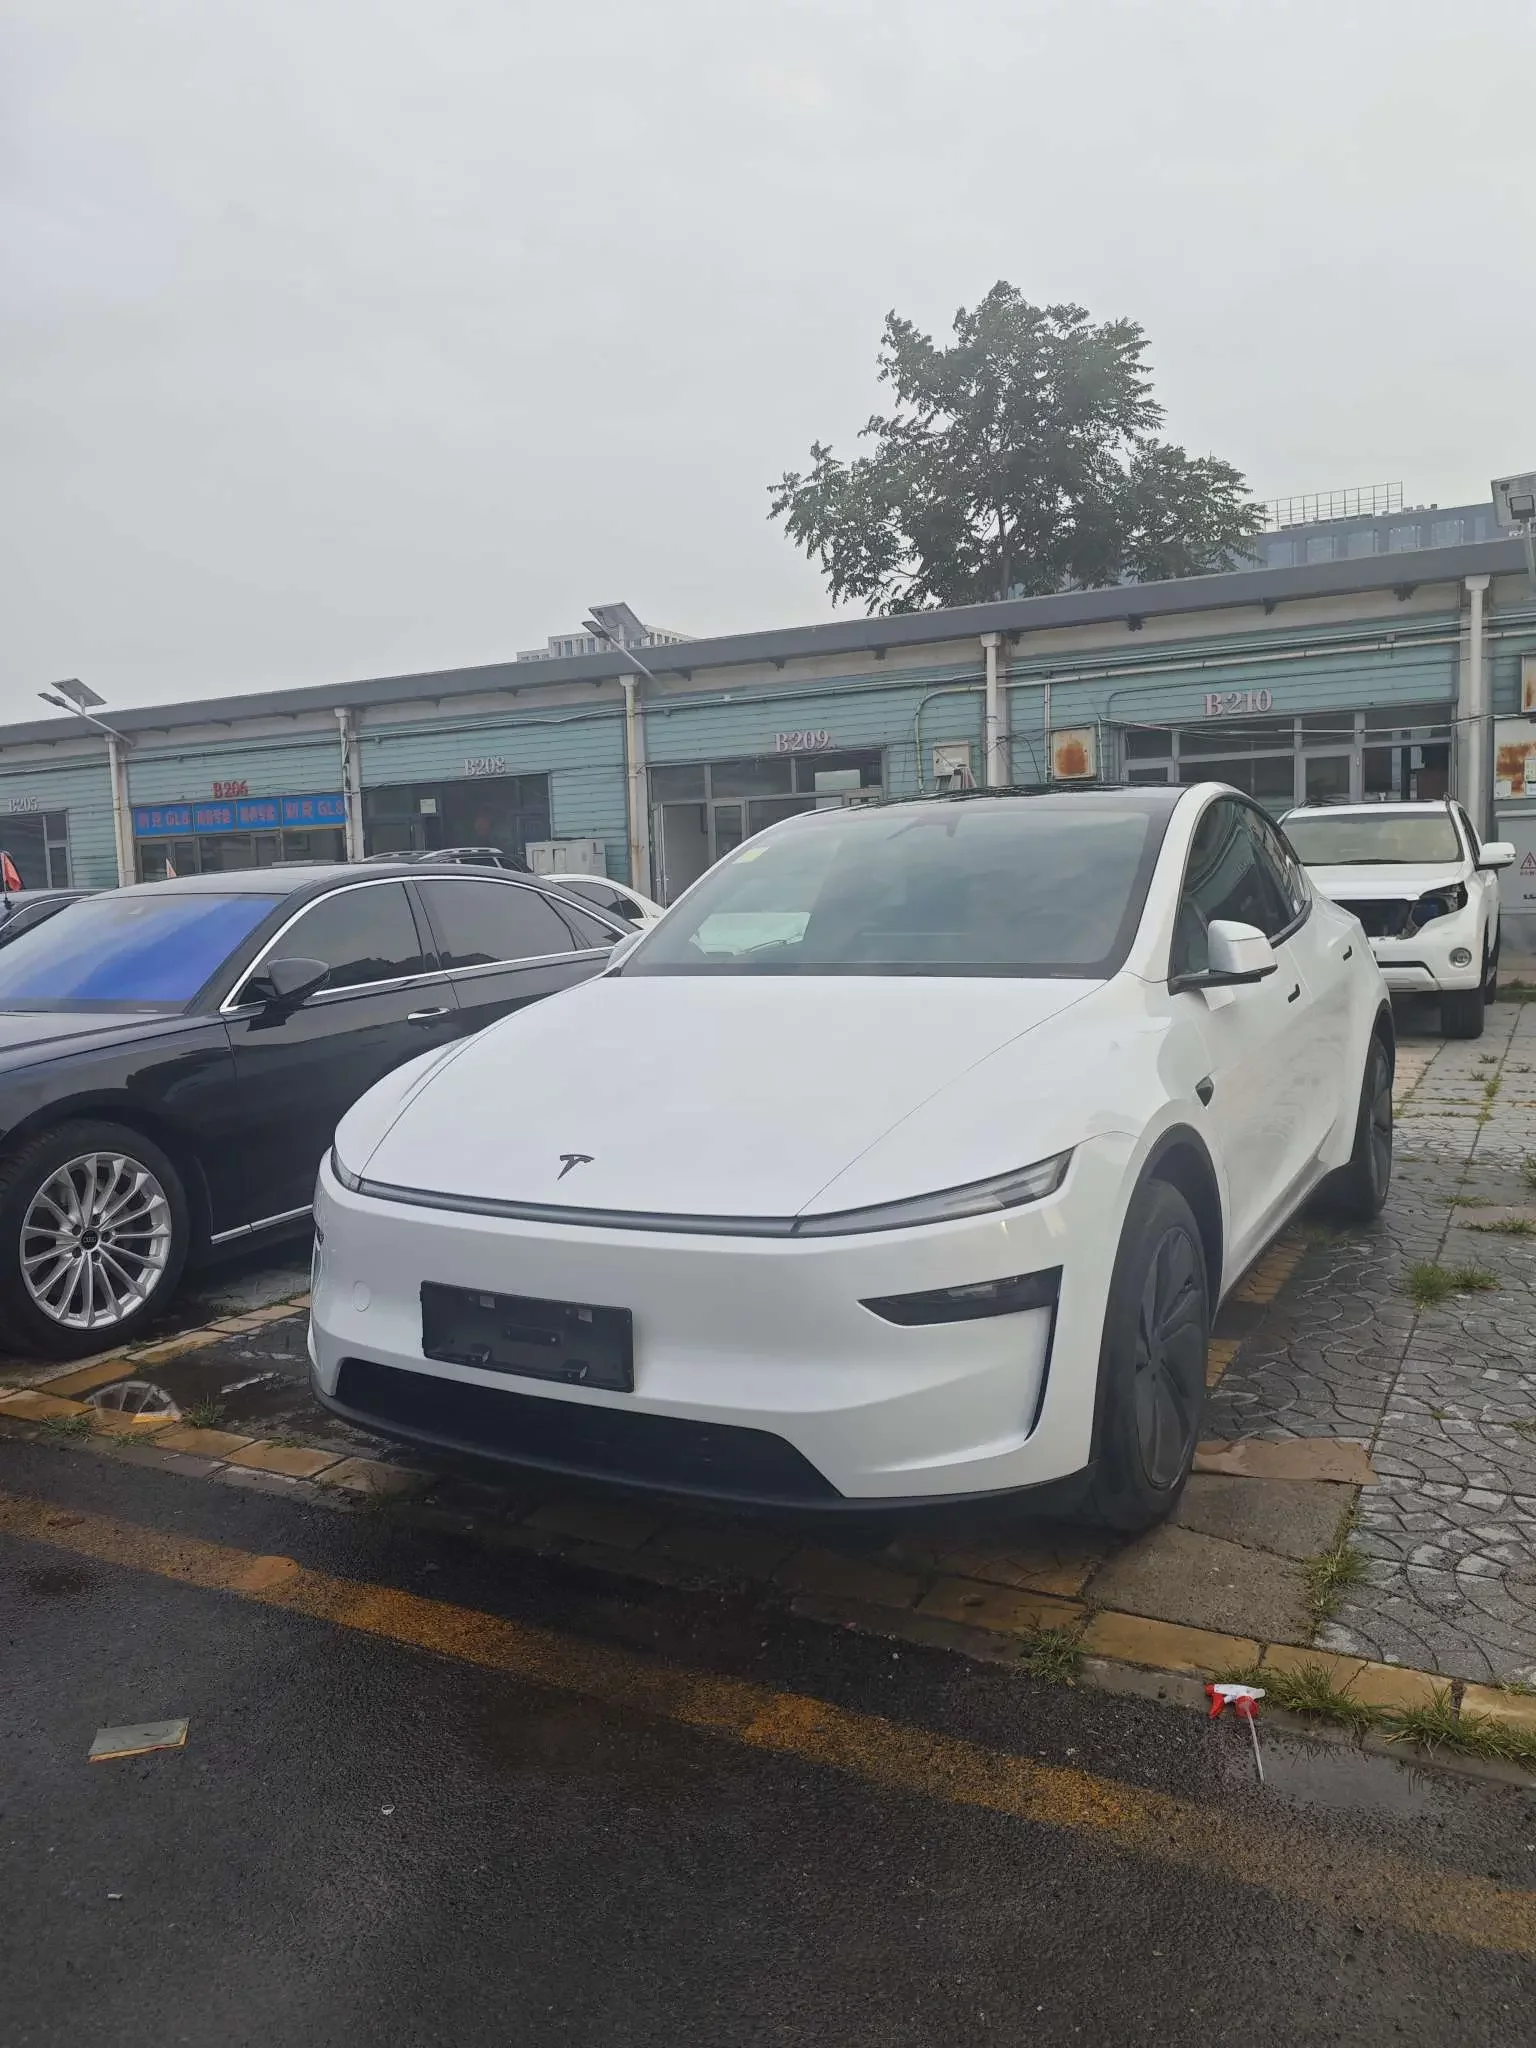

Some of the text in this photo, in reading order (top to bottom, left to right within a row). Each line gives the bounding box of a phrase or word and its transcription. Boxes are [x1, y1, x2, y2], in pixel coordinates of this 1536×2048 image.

[1205, 688, 1272, 716] B210
[775, 730, 829, 752] B209
[464, 755, 505, 776] B208
[213, 780, 249, 798] B206
